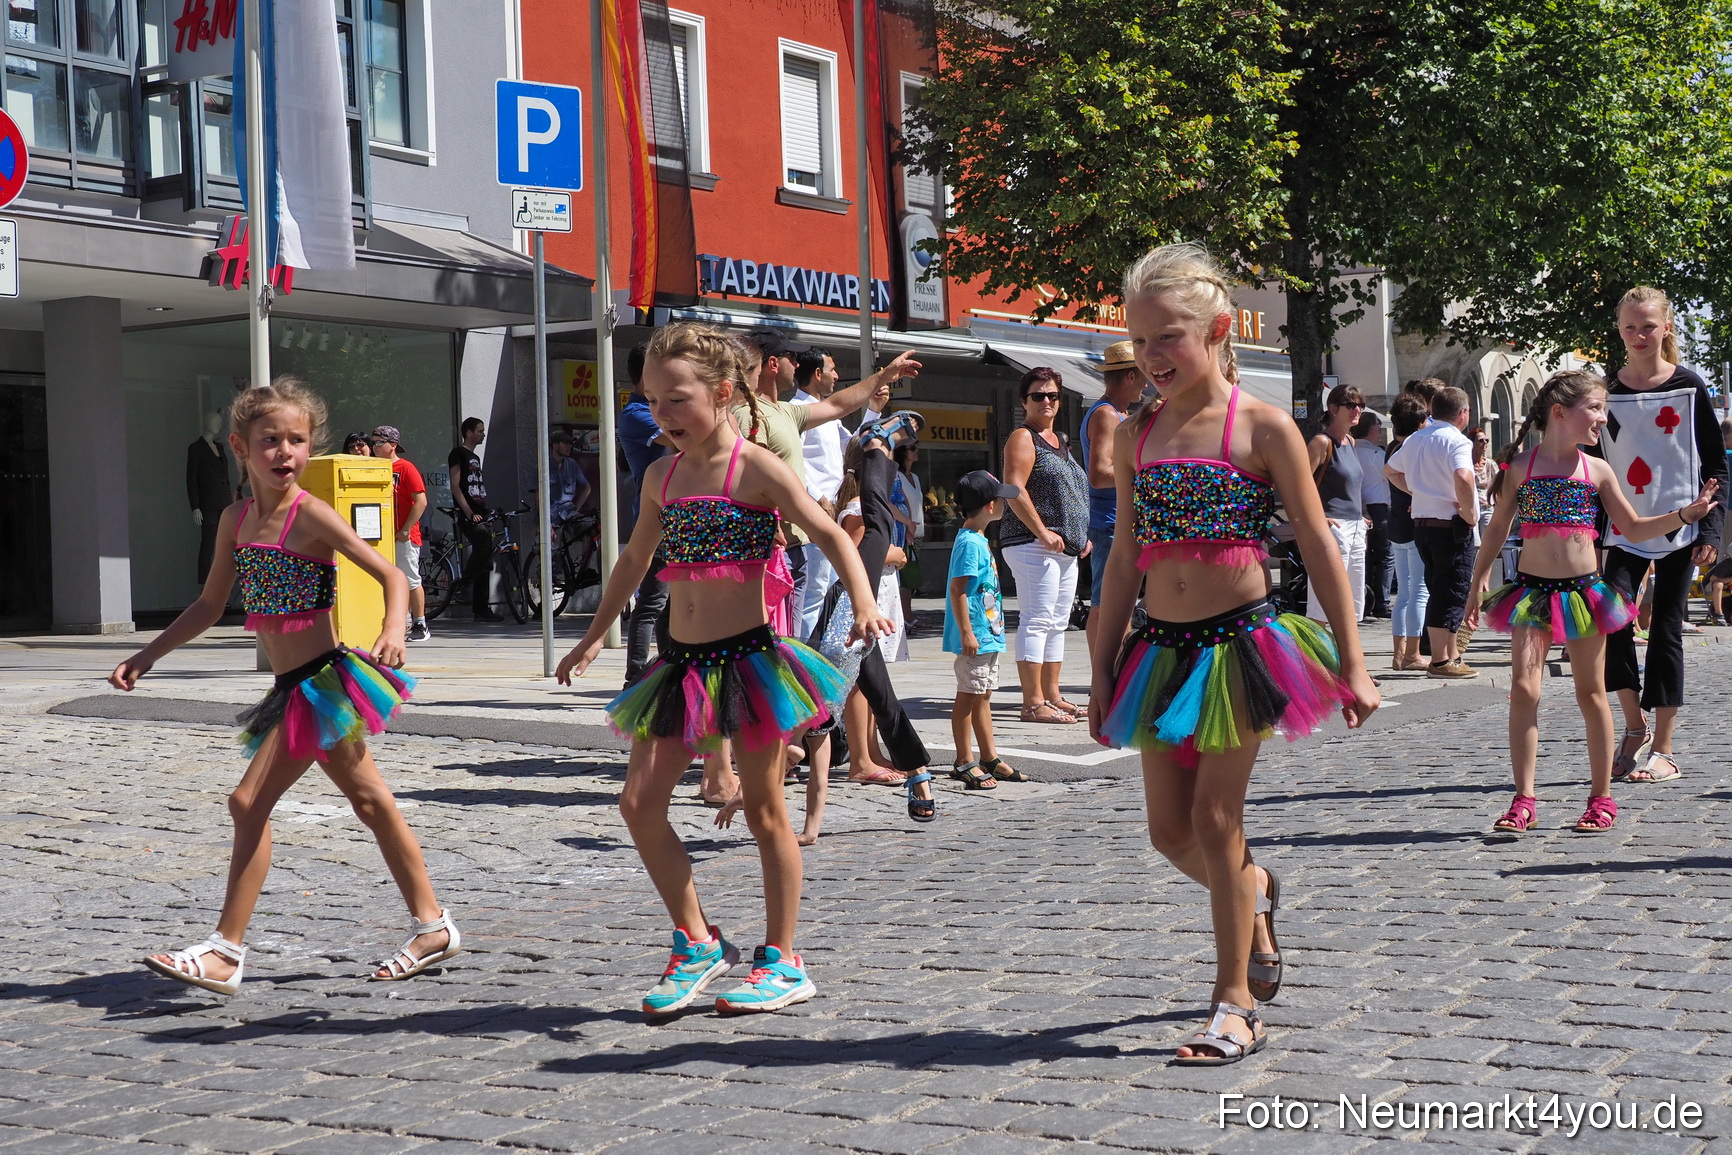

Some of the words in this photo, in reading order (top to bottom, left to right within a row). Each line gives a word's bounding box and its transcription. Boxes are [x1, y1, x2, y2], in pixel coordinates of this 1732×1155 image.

[517, 95, 561, 172] P
[914, 282, 937, 296] PRESSE
[913, 299, 941, 313] THUMANN
[567, 394, 599, 408] LOTTO
[930, 426, 988, 441] SCHLIERF
